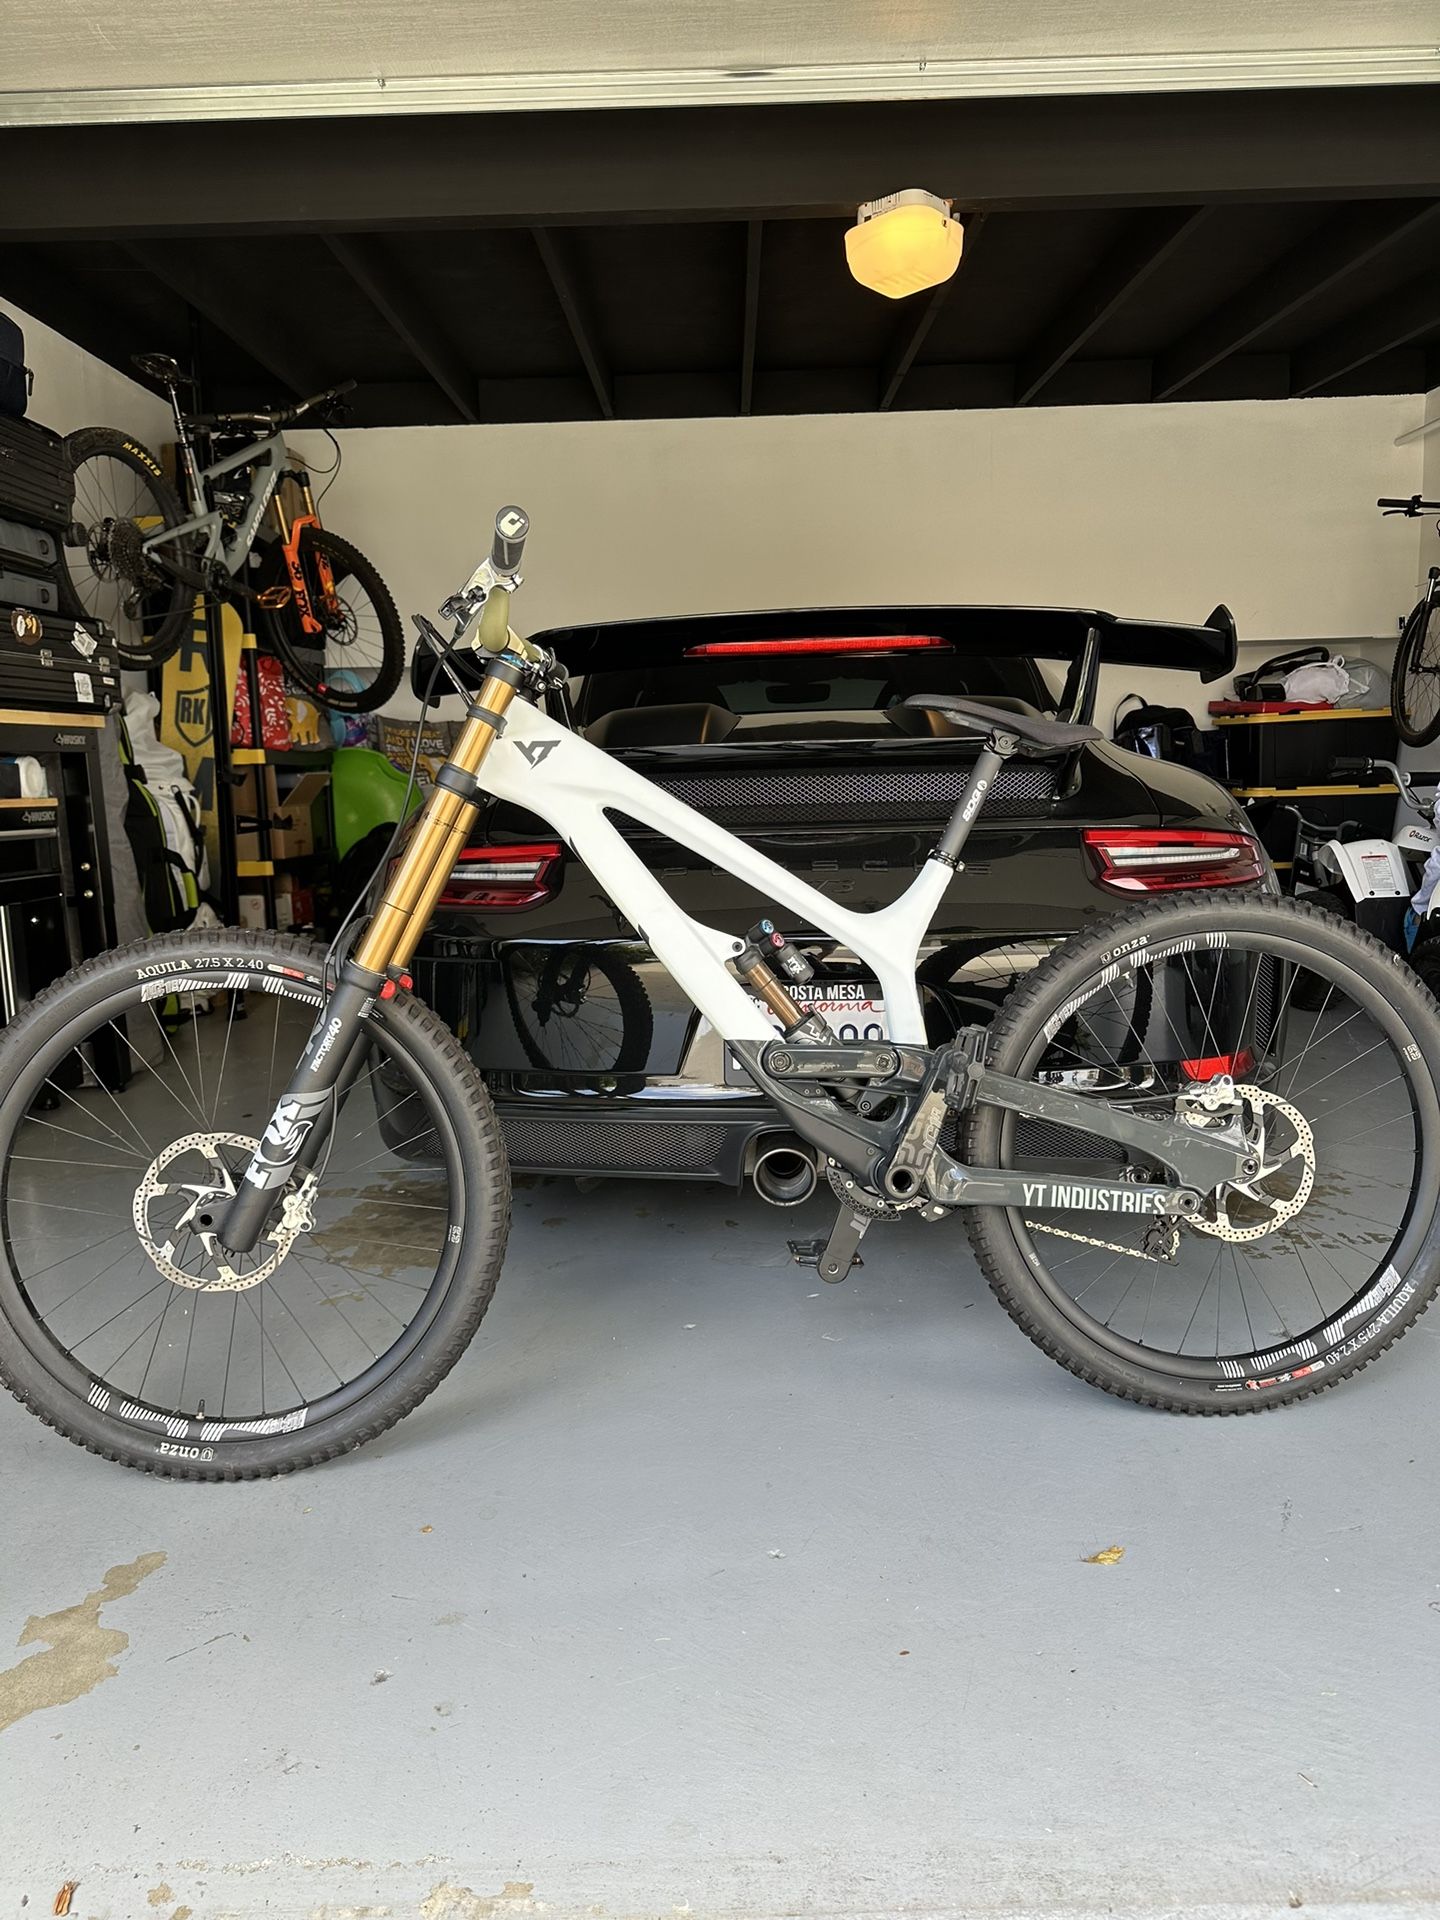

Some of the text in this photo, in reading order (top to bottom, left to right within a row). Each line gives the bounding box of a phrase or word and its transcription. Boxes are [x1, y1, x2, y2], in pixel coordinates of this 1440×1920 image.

[122, 442, 162, 477] MAXXIS
[180, 697, 206, 725] RK
[63, 735, 86, 745] HUSKY
[30, 811, 55, 822] HUSKY
[1113, 935, 1149, 957] onza
[136, 957, 264, 980] AQUILA 27.5 X 2.40
[826, 984, 866, 1000] MESA
[1022, 1183, 1166, 1215] YT INDUSTRIES
[1325, 1281, 1416, 1366] AQUILA 27.5 X 2.40
[160, 1442, 200, 1459] onza
